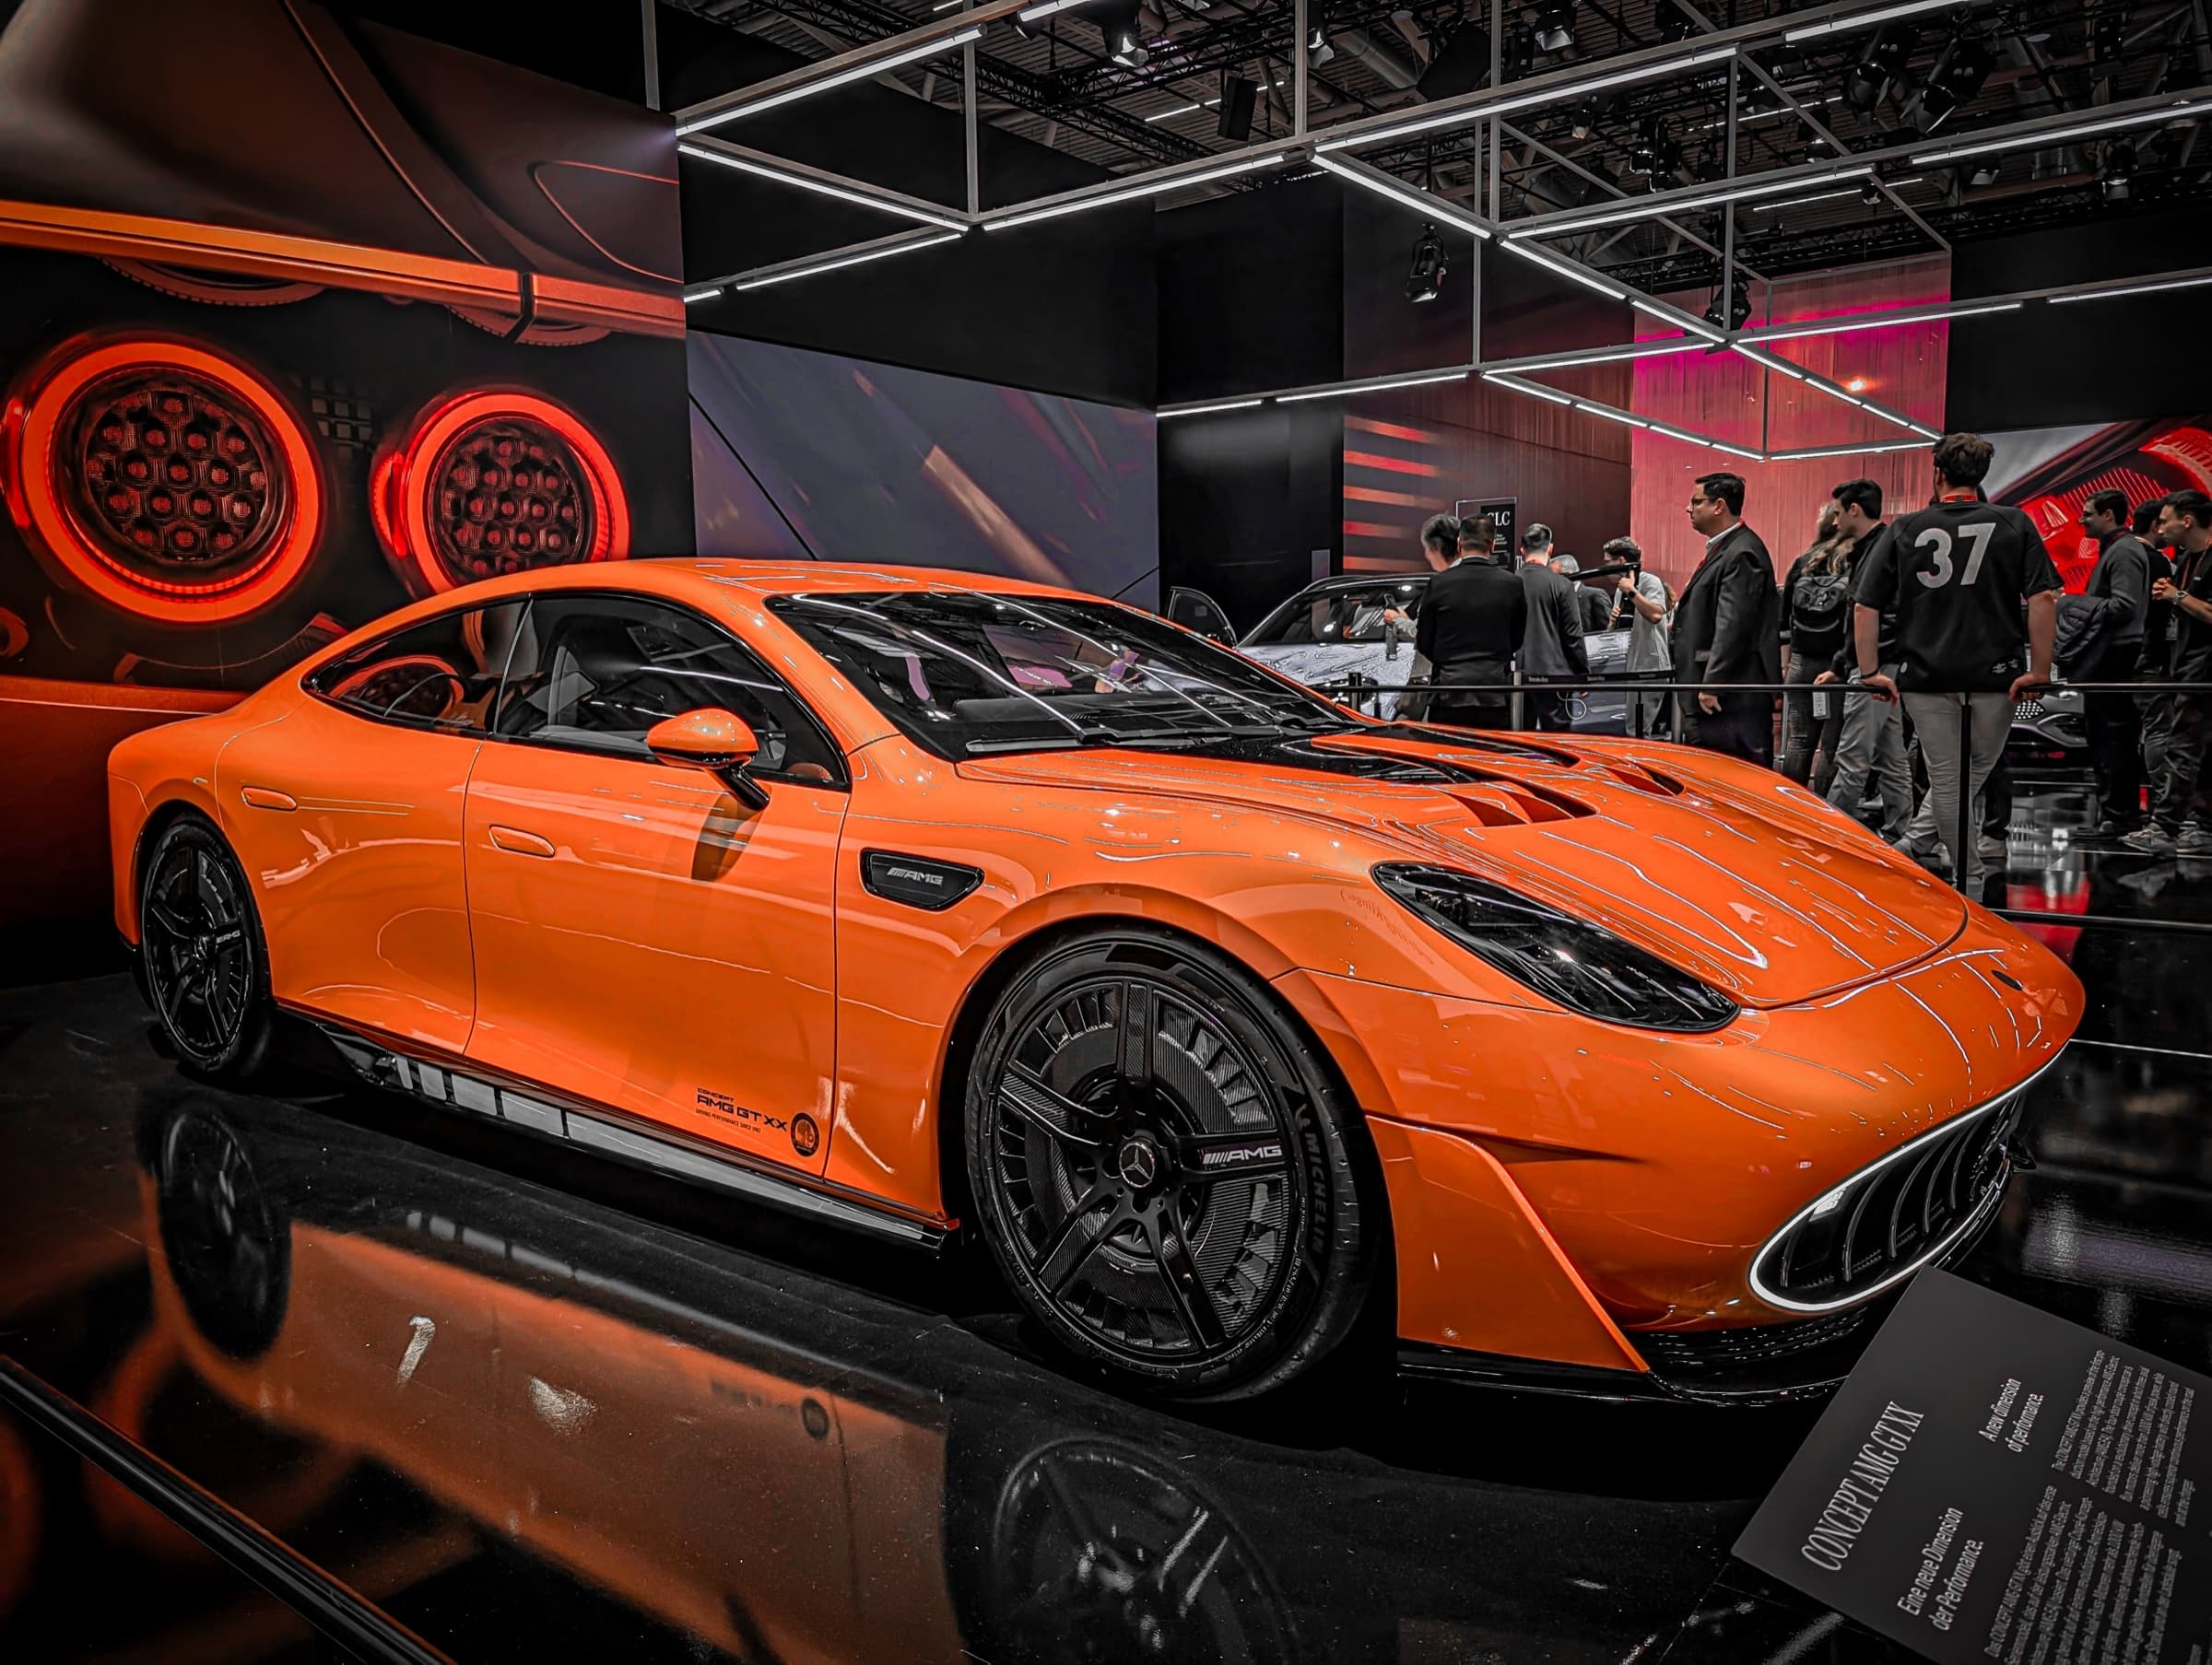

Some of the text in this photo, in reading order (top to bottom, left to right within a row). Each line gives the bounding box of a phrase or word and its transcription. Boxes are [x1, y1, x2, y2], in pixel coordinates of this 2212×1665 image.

[1914, 522, 1996, 589] 37
[697, 1087, 735, 1102] CONCEPT
[697, 1095, 788, 1131] AMG GT XX
[1227, 1144, 1282, 1163] AMG
[1305, 1133, 1326, 1252] MICHELIN
[1978, 1378, 2021, 1442] A new dimension
[2005, 1393, 2044, 1452] of performance.
[1801, 1401, 1924, 1571] CONCEPT AMG GT XX
[1897, 1507, 1963, 1616] Eine neue Dimension
[1928, 1540, 1983, 1631] der Performance.
